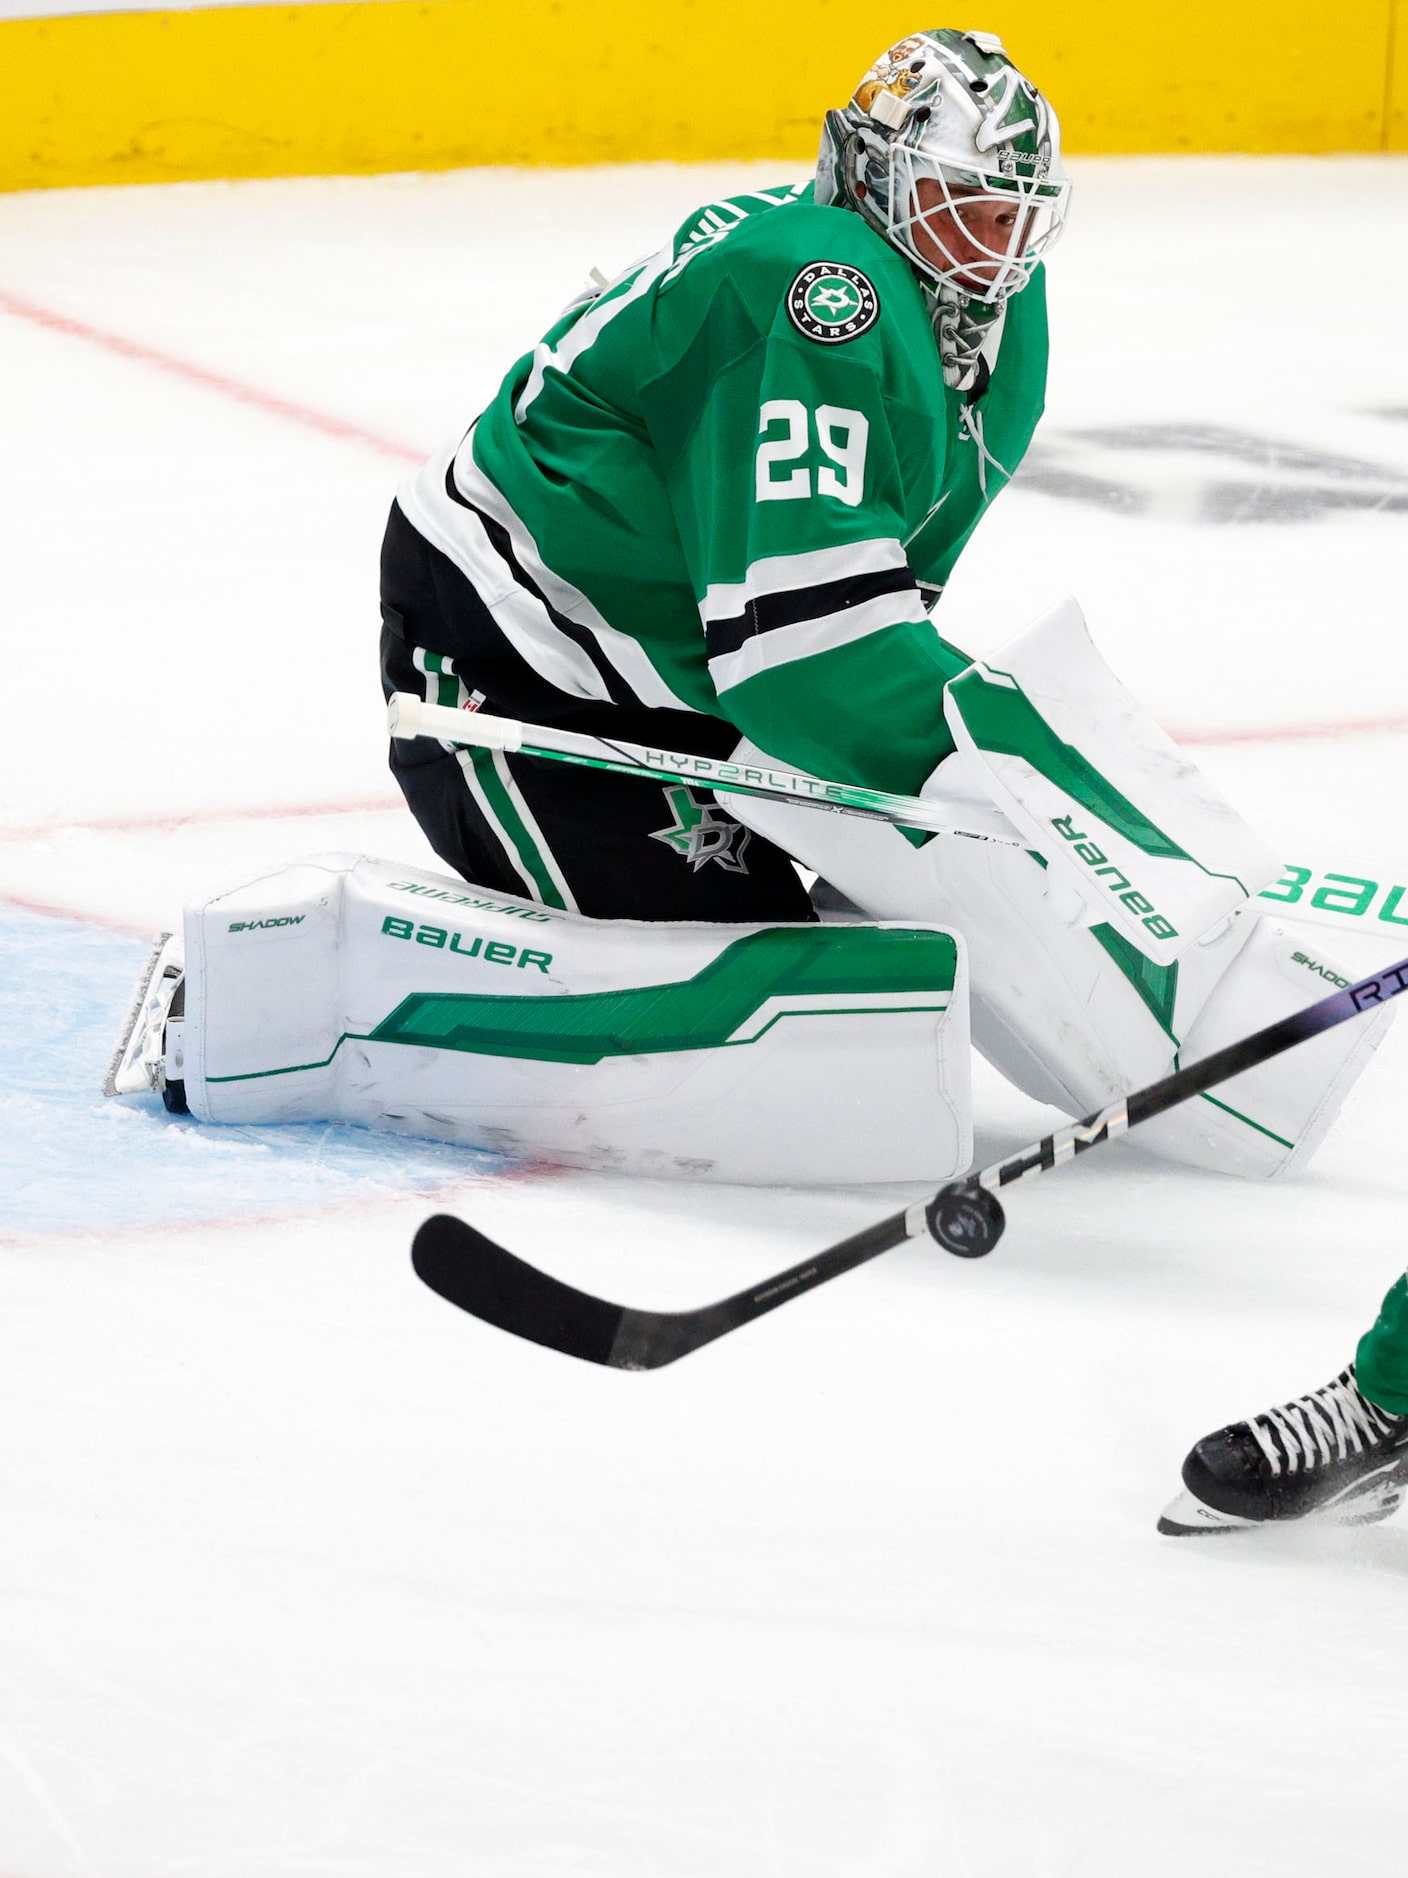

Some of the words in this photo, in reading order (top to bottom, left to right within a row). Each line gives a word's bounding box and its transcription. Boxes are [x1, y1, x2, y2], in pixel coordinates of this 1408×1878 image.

[803, 266, 874, 310] DALLAS
[794, 299, 857, 337] STARS
[756, 399, 869, 507] 29
[228, 915, 306, 932] SHADOW
[1290, 951, 1352, 988] SHADO
